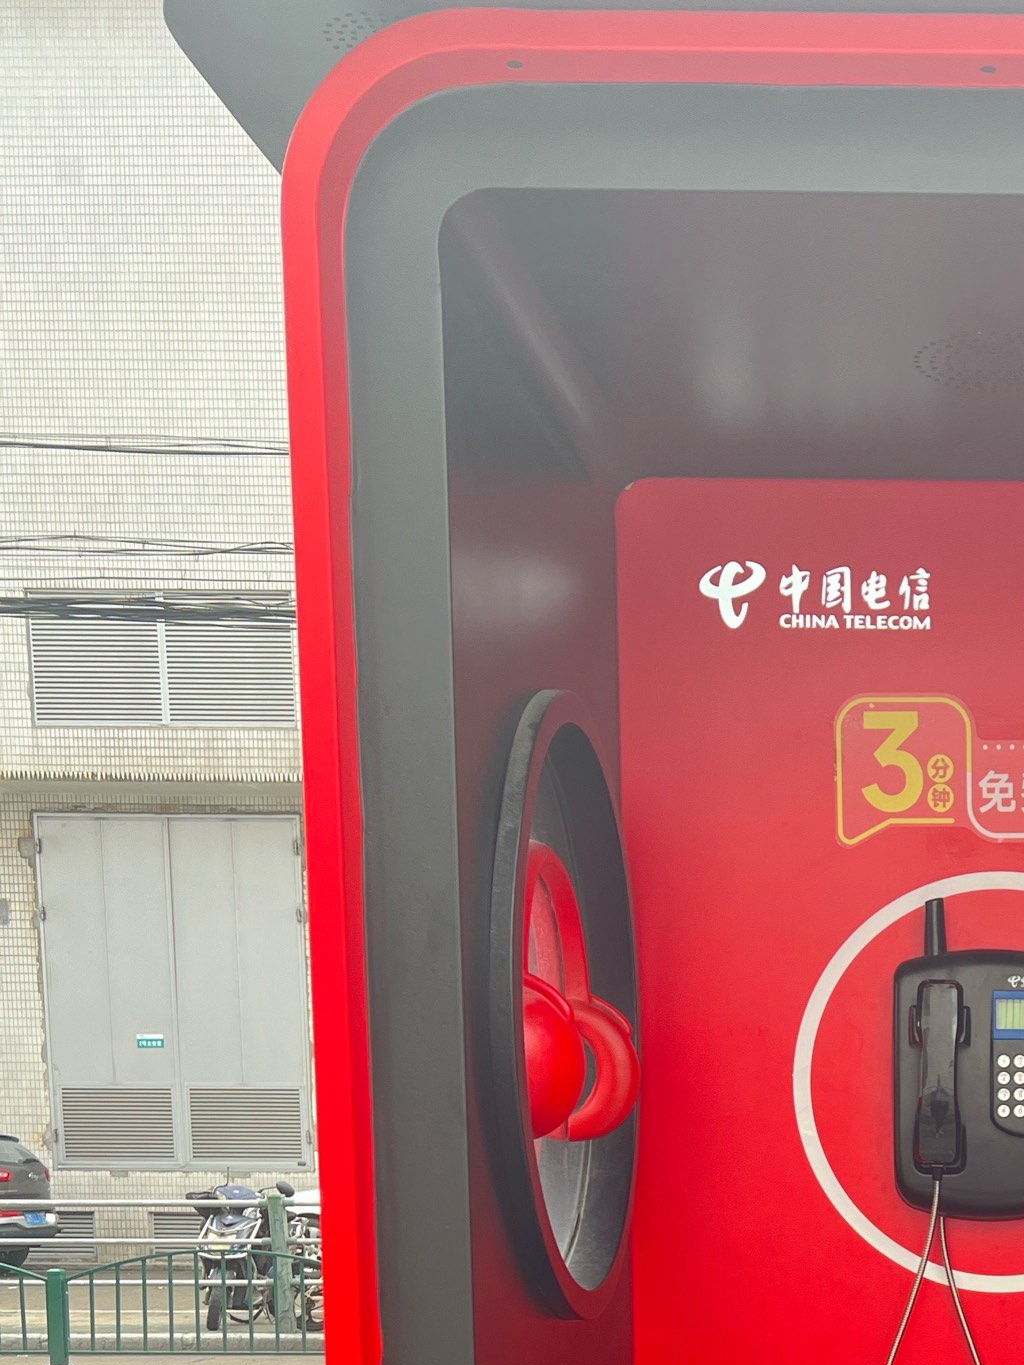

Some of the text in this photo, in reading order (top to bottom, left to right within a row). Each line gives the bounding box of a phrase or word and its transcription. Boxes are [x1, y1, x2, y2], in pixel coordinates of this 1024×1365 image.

[779, 564, 931, 613] 中国电信
[779, 614, 931, 630] CHINA TELECOM
[861, 711, 924, 813] 3
[929, 757, 952, 810] 分钟
